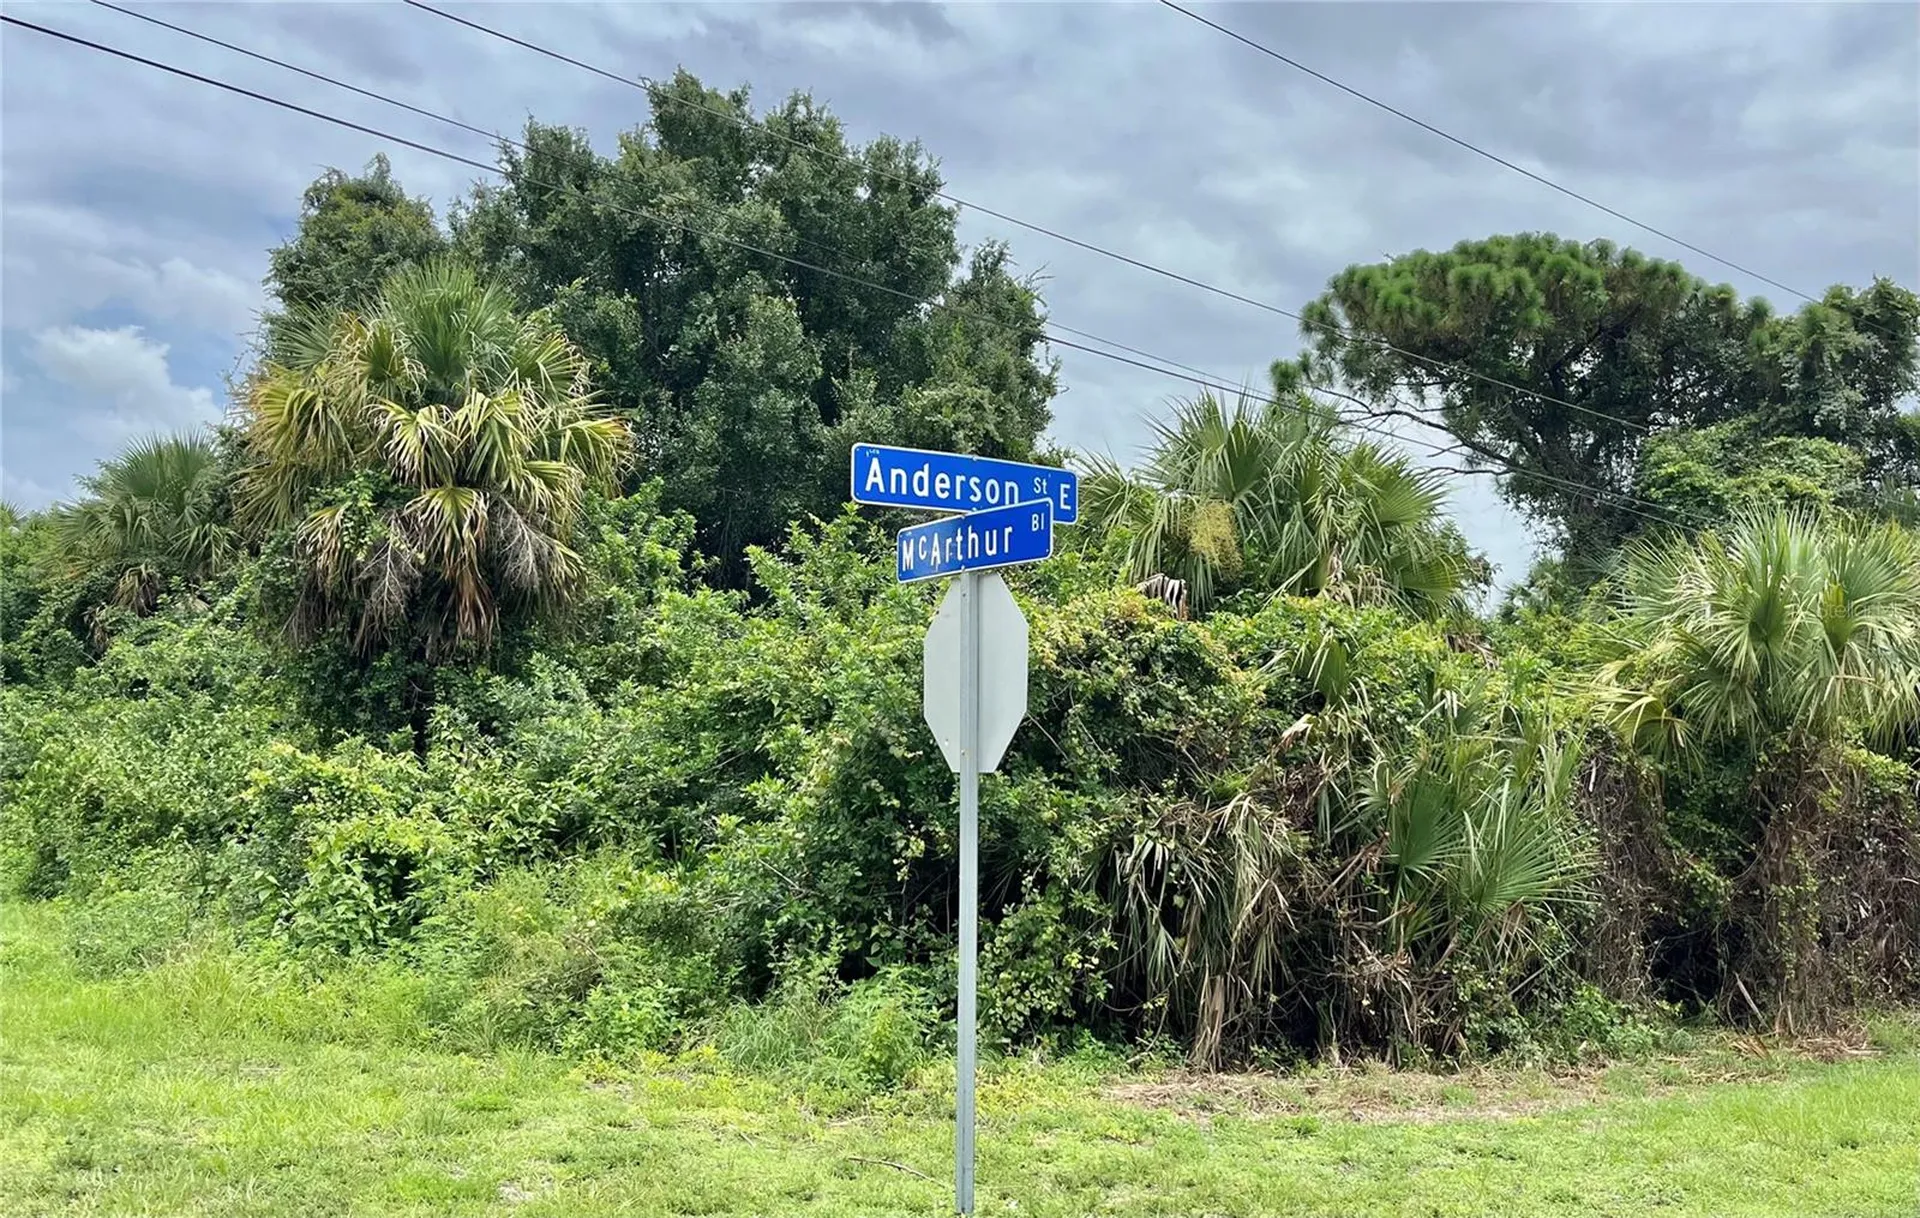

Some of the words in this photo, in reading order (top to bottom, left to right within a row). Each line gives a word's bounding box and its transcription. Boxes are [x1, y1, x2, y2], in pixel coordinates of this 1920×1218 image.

[865, 457, 1019, 505] Anderson
[1033, 477, 1047, 494] St
[1060, 484, 1071, 509] E
[902, 525, 1013, 571] McArthur
[1031, 513, 1045, 531] Bl
